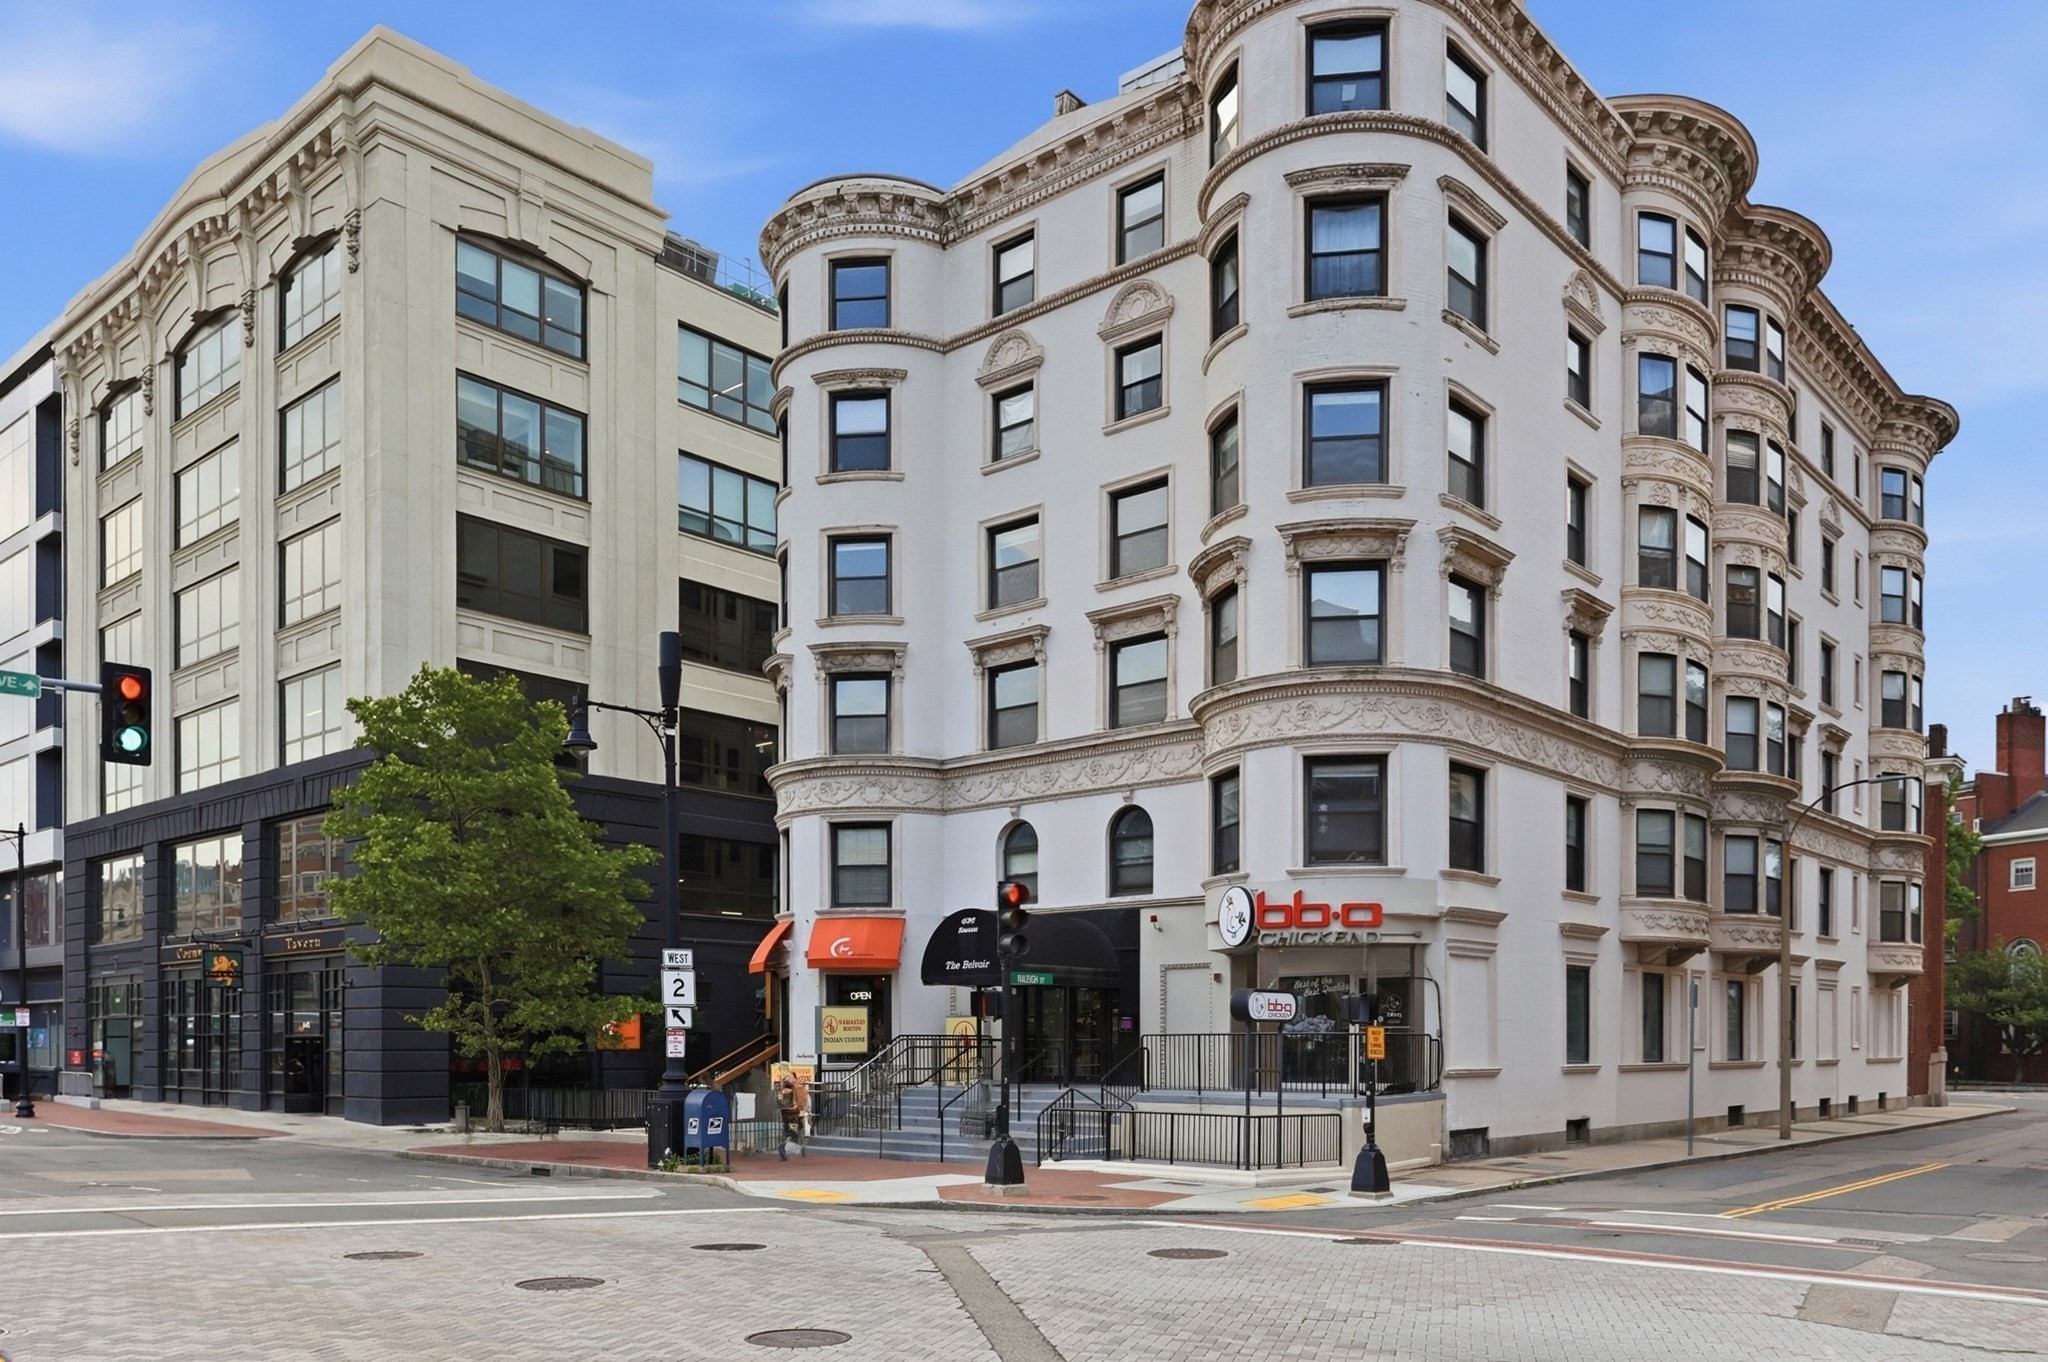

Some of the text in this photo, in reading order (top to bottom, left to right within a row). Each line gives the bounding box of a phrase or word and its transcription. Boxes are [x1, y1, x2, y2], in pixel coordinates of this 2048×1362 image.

[285, 937, 321, 950] Tavern
[667, 952, 689, 964] WEST
[945, 960, 961, 970] The
[1016, 974, 1039, 984] RALEIGH
[1293, 976, 1333, 989] Best of the
[672, 978, 685, 997] 2
[1303, 988, 1320, 997] Best
[849, 991, 872, 1001] OPEN
